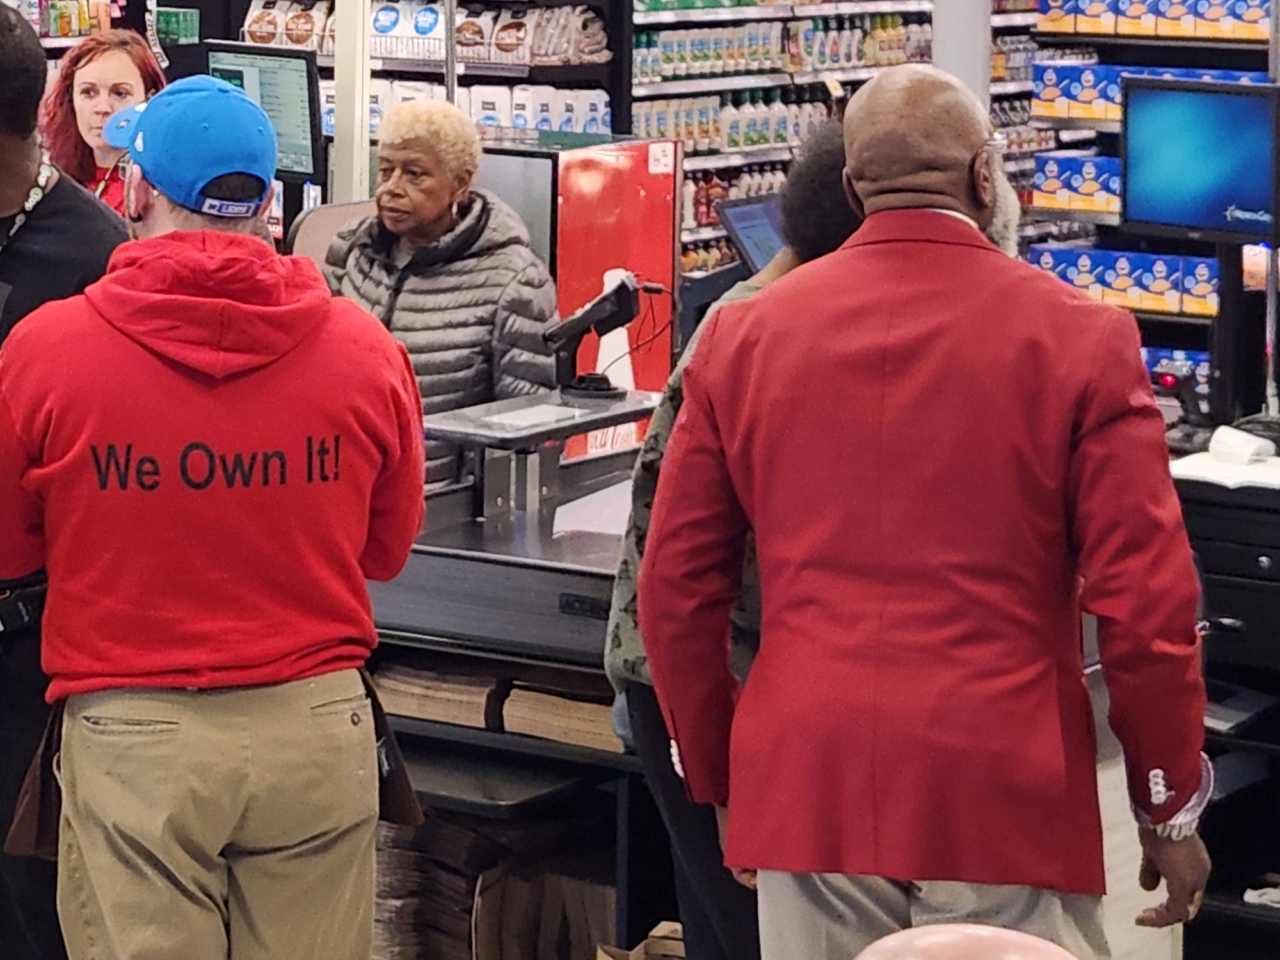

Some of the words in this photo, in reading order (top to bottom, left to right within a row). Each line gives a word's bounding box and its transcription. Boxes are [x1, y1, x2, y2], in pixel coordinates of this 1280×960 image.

[90, 443, 161, 491] We
[179, 441, 288, 490] Own
[305, 435, 341, 483] It!
